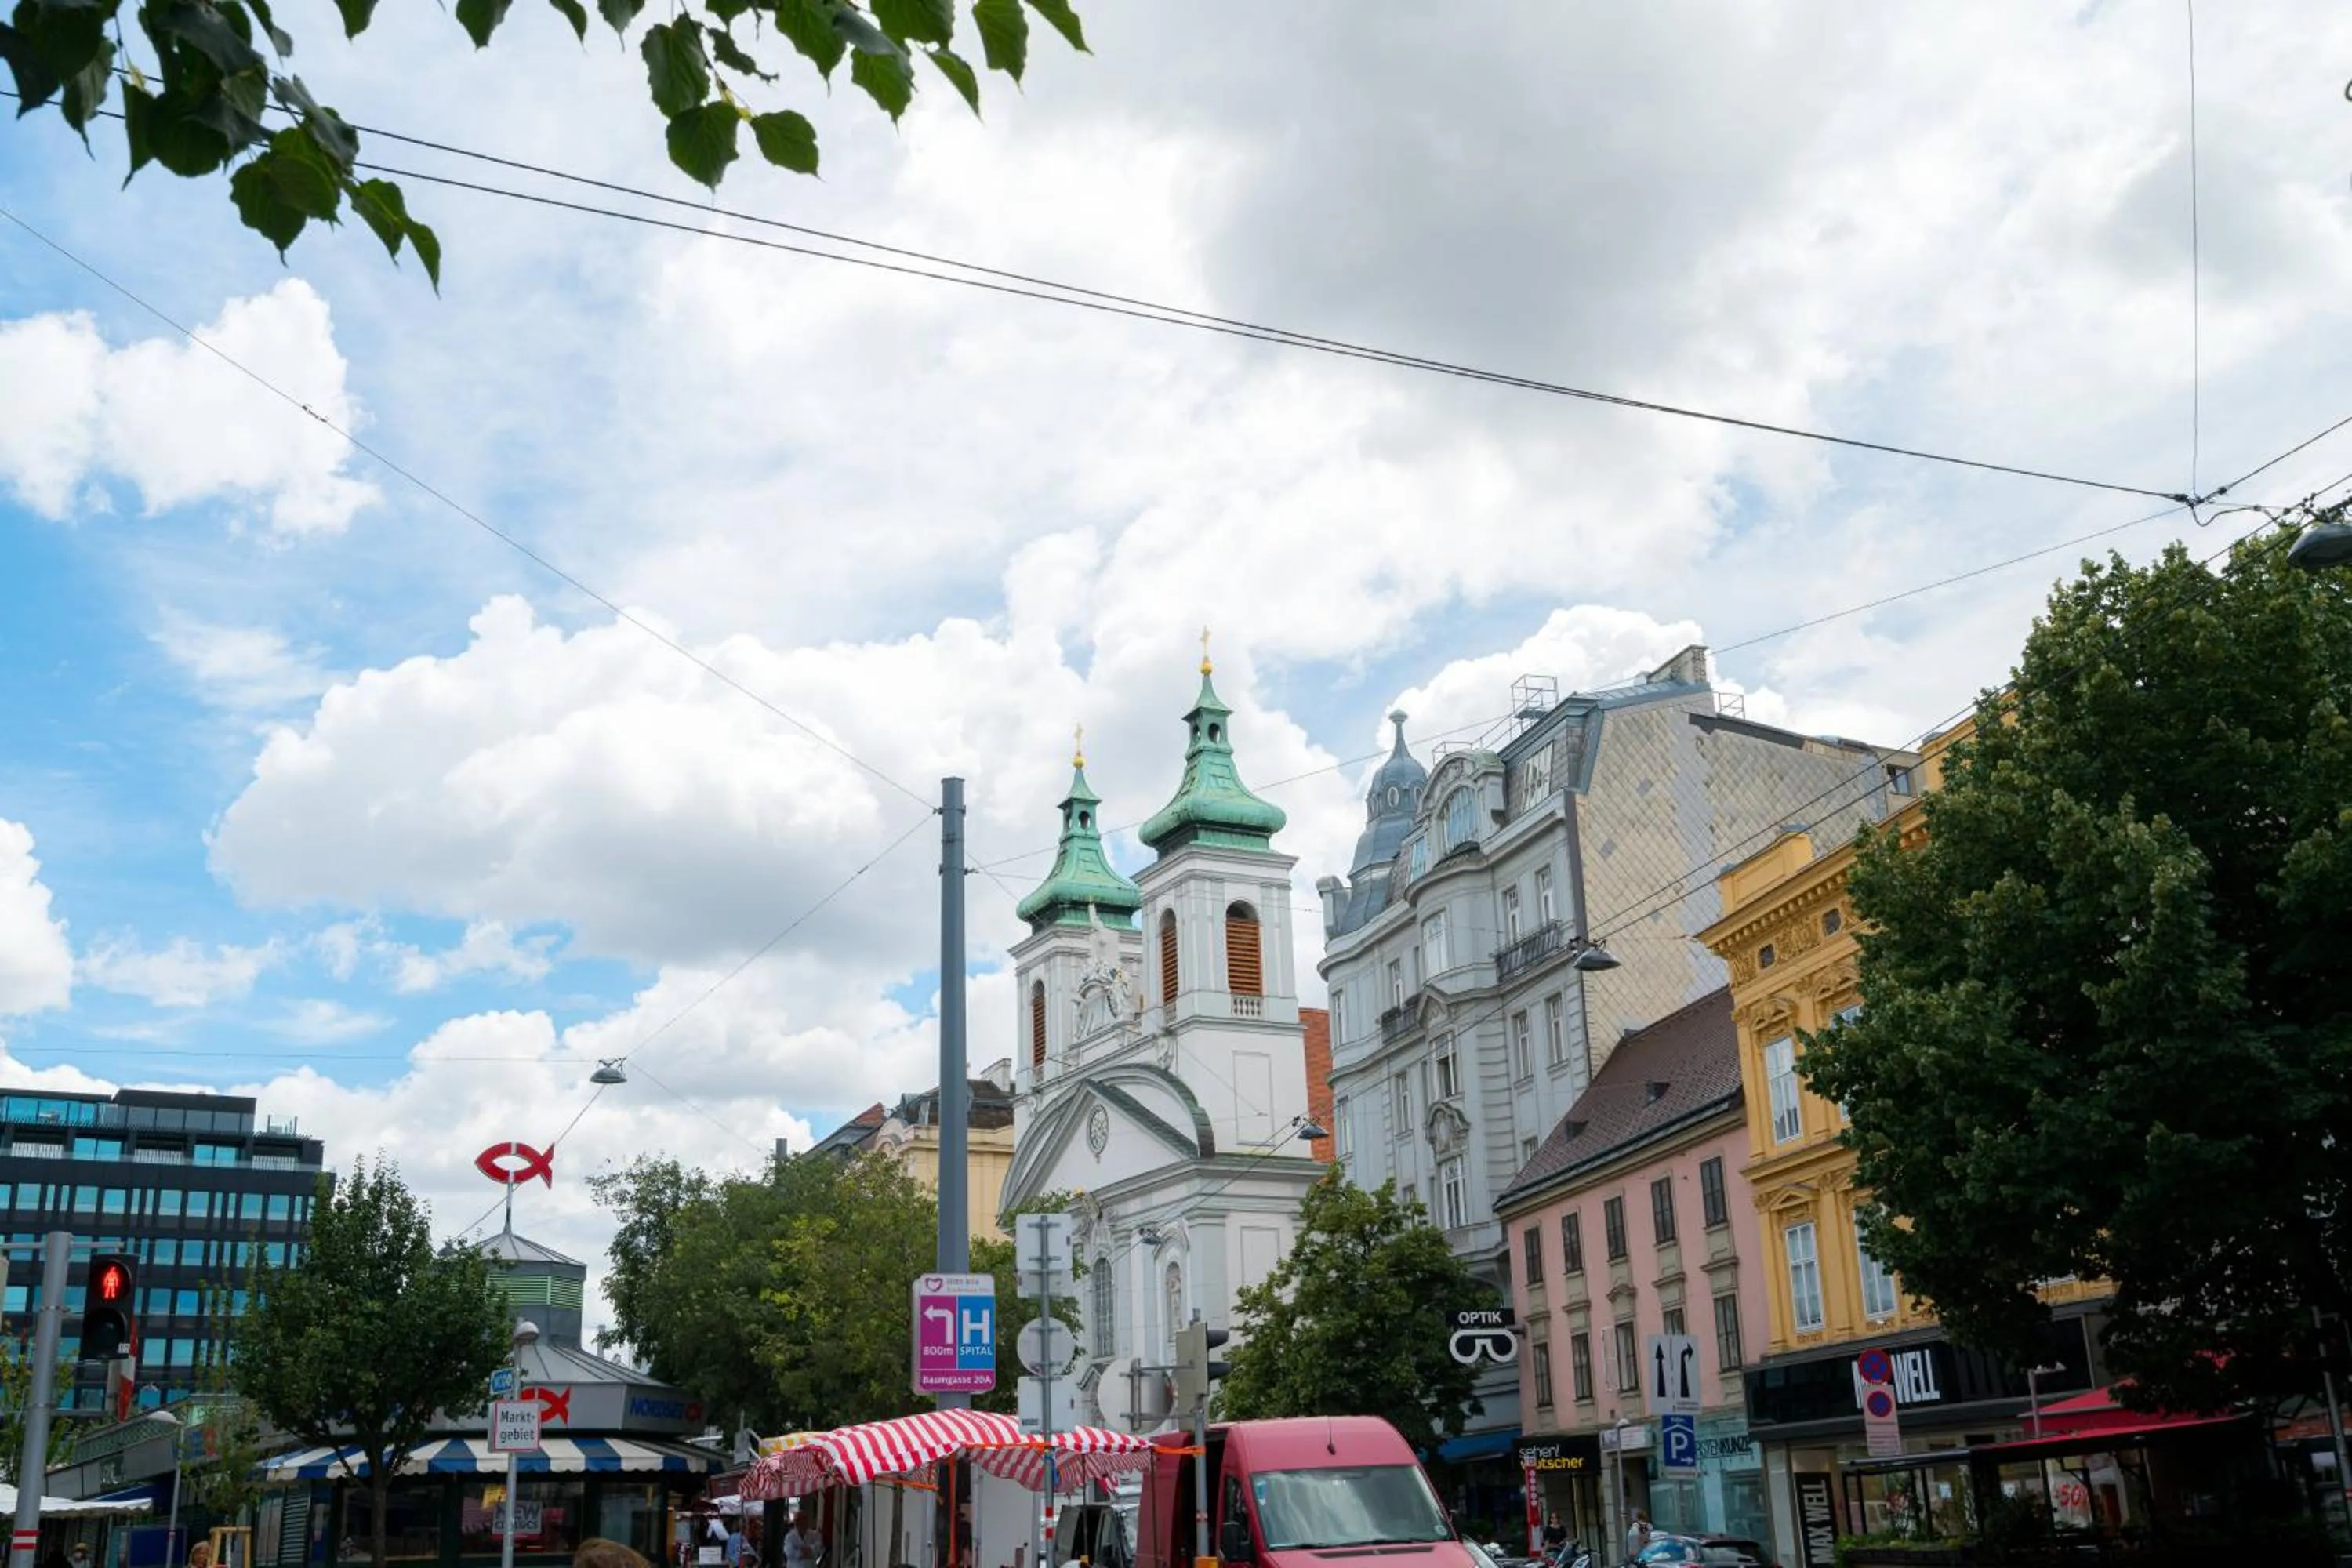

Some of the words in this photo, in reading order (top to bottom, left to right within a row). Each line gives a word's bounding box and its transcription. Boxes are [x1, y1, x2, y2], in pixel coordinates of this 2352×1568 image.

[1458, 1311, 1502, 1324] OPTIK
[962, 1308, 990, 1345] H
[923, 1346, 954, 1356] 800m
[959, 1346, 993, 1356] SPITAL
[922, 1376, 972, 1386] Baumgasse
[973, 1375, 992, 1385] 20A
[1890, 1349, 1940, 1404] WELL
[501, 1410, 535, 1423] Markt-
[500, 1428, 535, 1443] gebiet
[1519, 1443, 1560, 1458] sehen!
[1671, 1432, 1688, 1459] P
[1802, 1479, 1831, 1523] WELL
[1807, 1526, 1836, 1564] MAX
